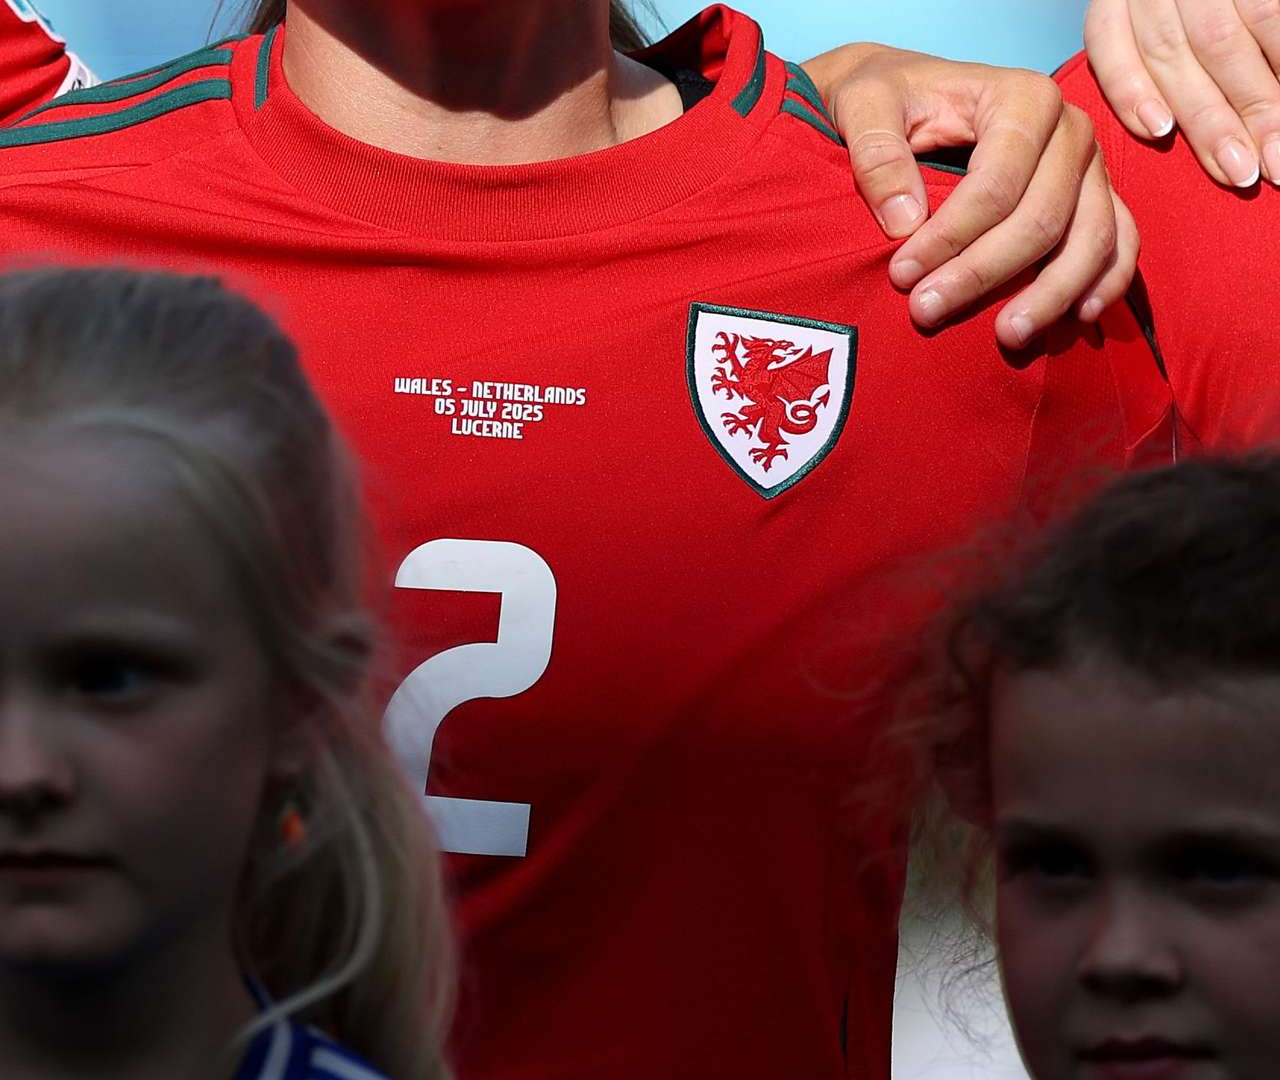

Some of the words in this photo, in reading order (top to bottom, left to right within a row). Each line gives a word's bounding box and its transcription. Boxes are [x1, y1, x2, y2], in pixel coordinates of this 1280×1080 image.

[394, 377, 452, 396] WALES
[472, 381, 586, 406] NETHERLANDS
[434, 397, 456, 416] 05
[459, 399, 498, 419] JULY
[501, 402, 544, 422] 2025
[451, 417, 524, 440] LUCERNE
[384, 538, 557, 857] 2
